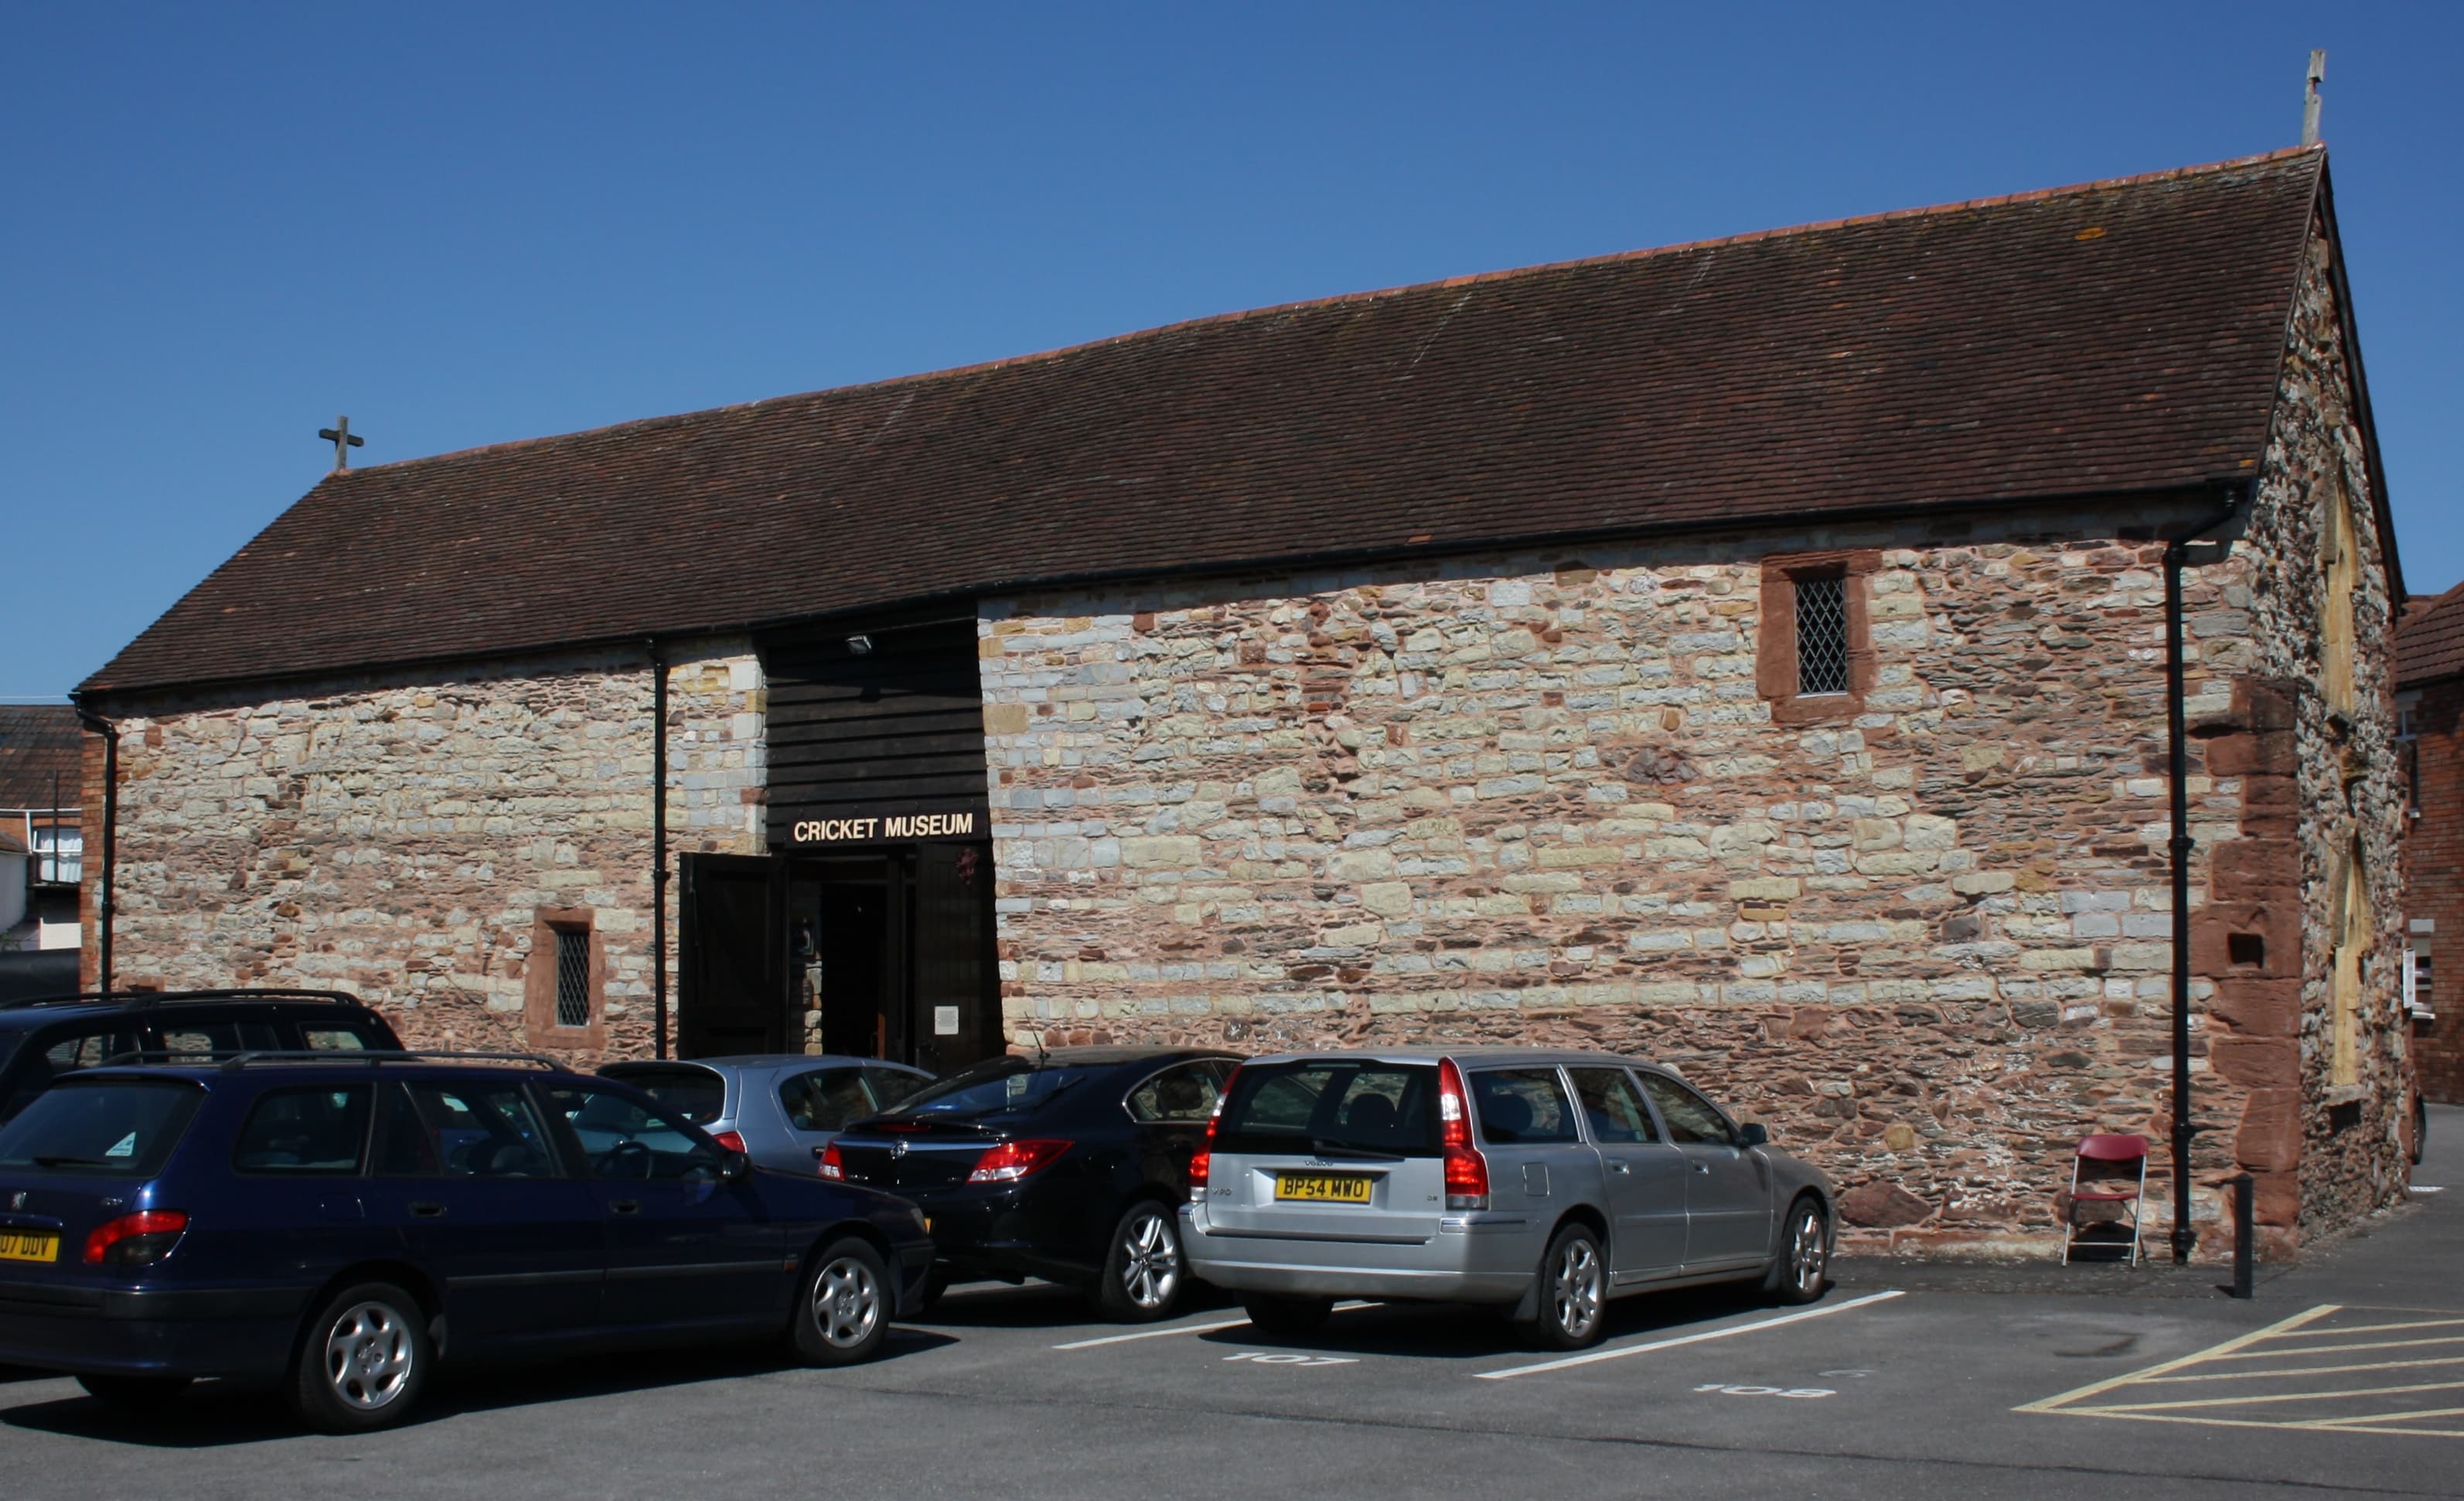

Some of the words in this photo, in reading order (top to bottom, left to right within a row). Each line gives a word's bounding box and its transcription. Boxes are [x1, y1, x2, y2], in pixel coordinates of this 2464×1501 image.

[794, 818, 878, 841] CRICKET
[885, 813, 973, 837] MUSEUM
[1283, 1177, 1326, 1196] BP54
[1331, 1179, 1365, 1197] MWO
[1222, 1353, 1360, 1366] 107
[1693, 1384, 1837, 1397] 108
